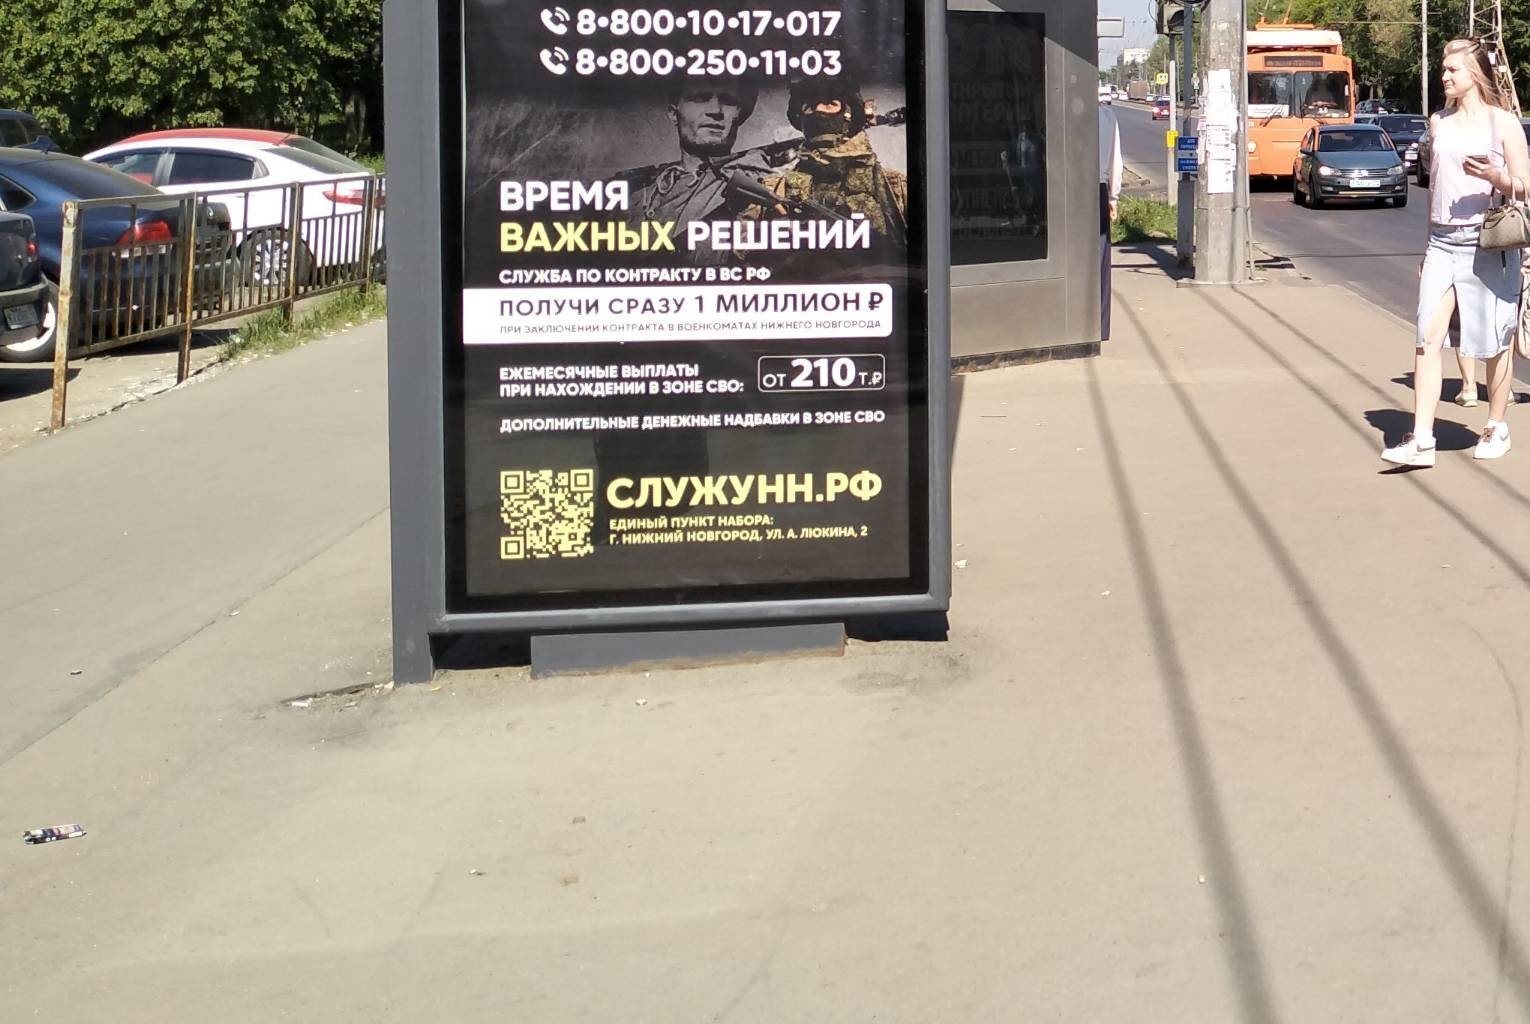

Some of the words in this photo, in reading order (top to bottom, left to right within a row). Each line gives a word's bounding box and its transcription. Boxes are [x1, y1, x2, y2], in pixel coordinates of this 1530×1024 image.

[500, 180, 629, 212] ВРЕМЯ
[500, 220, 678, 253] ВАЖНЫХ
[686, 212, 871, 252] РЕШЕНИЙ
[498, 268, 573, 285] СЛУЖБА
[575, 268, 602, 283] ПО
[604, 267, 703, 283] КОНТРАКТУ
[705, 267, 717, 282] В
[719, 266, 743, 282] ВС
[745, 266, 771, 281] РФ
[500, 298, 599, 317] ПОЛУЧИ
[608, 297, 685, 315] СРАЗУ
[694, 295, 704, 314] 1
[716, 292, 860, 313] МИЛЛИОН
[500, 325, 522, 334] ПРИ
[525, 324, 600, 334] ЗАКЛЮЧЕНИИ
[602, 323, 665, 332] КОНТРАКТА
[677, 321, 758, 332] ВОЕНКОМАТАХ
[760, 320, 813, 330] НИЖНЕГО
[815, 320, 881, 329] НОВГОРОДА
[499, 364, 619, 381] ЕЖЕМЕСЯЧНЫЕ
[621, 363, 699, 379] ВЫПЛАТЫ
[761, 372, 787, 390] ОТ
[789, 357, 857, 389] 210
[499, 383, 532, 398] ПРИ
[534, 380, 646, 398] НАХОЖДЕНИИ
[648, 380, 660, 395] В
[662, 379, 704, 394] ЗОНЕ
[705, 379, 745, 393] СВО:
[499, 415, 640, 434] ДОПОЛНИТЕЛЬНЫЕ
[641, 413, 722, 431] ДЕНЕЖНЫЕ
[723, 412, 801, 428] НАДБАВКИ
[802, 411, 813, 425] В
[814, 410, 852, 425] ЗОНЕ
[853, 410, 886, 424] СВО
[606, 469, 883, 509] СЛУЖУНН.РФ
[609, 515, 668, 532] ЕДИНЫЙ
[670, 515, 716, 530] ПУНКТ
[717, 514, 774, 527] НАБОРА:
[609, 533, 621, 546] Г.
[622, 528, 684, 545] НИЖНИЙ
[686, 529, 763, 543] НОВГОРОД,
[765, 528, 785, 540] УЛ.
[859, 524, 869, 538] 2
